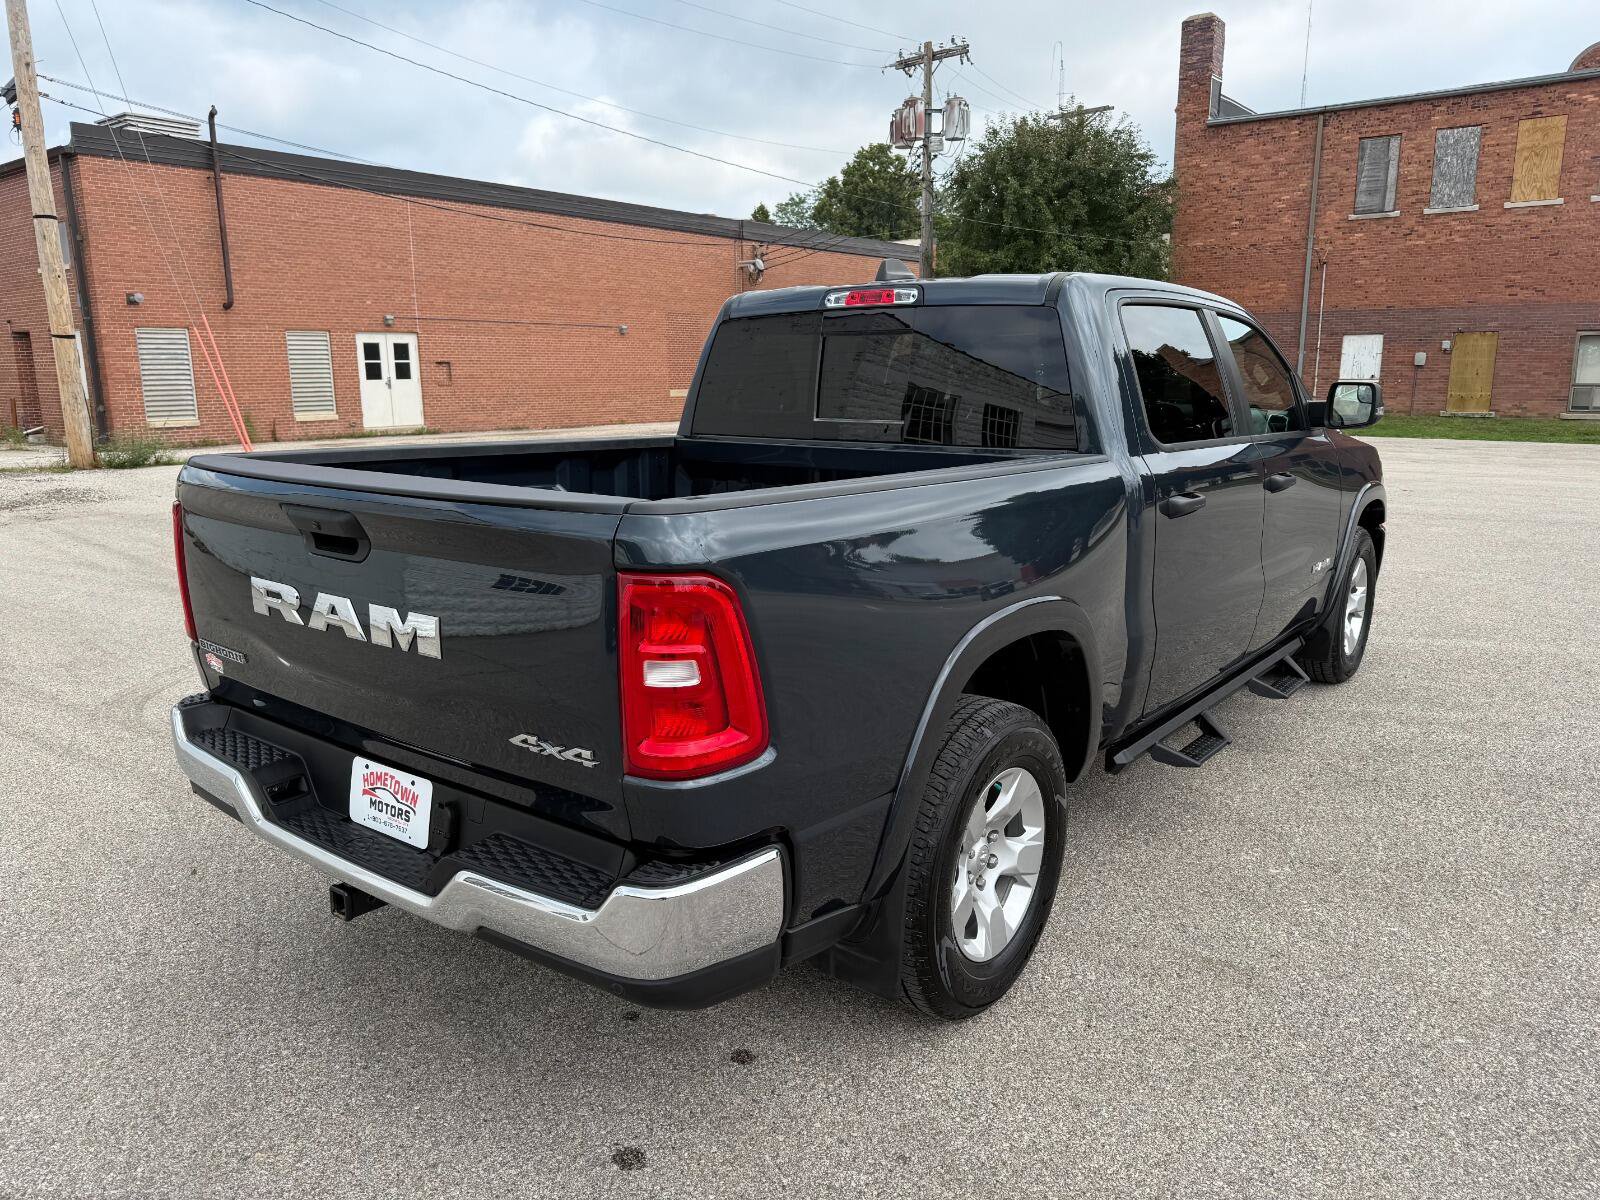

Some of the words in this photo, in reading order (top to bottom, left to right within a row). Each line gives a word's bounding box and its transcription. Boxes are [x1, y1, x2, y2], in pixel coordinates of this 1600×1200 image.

[250, 576, 442, 660] RAM
[362, 771, 419, 808] HOMETOWN
[369, 797, 411, 823] MOTORS
